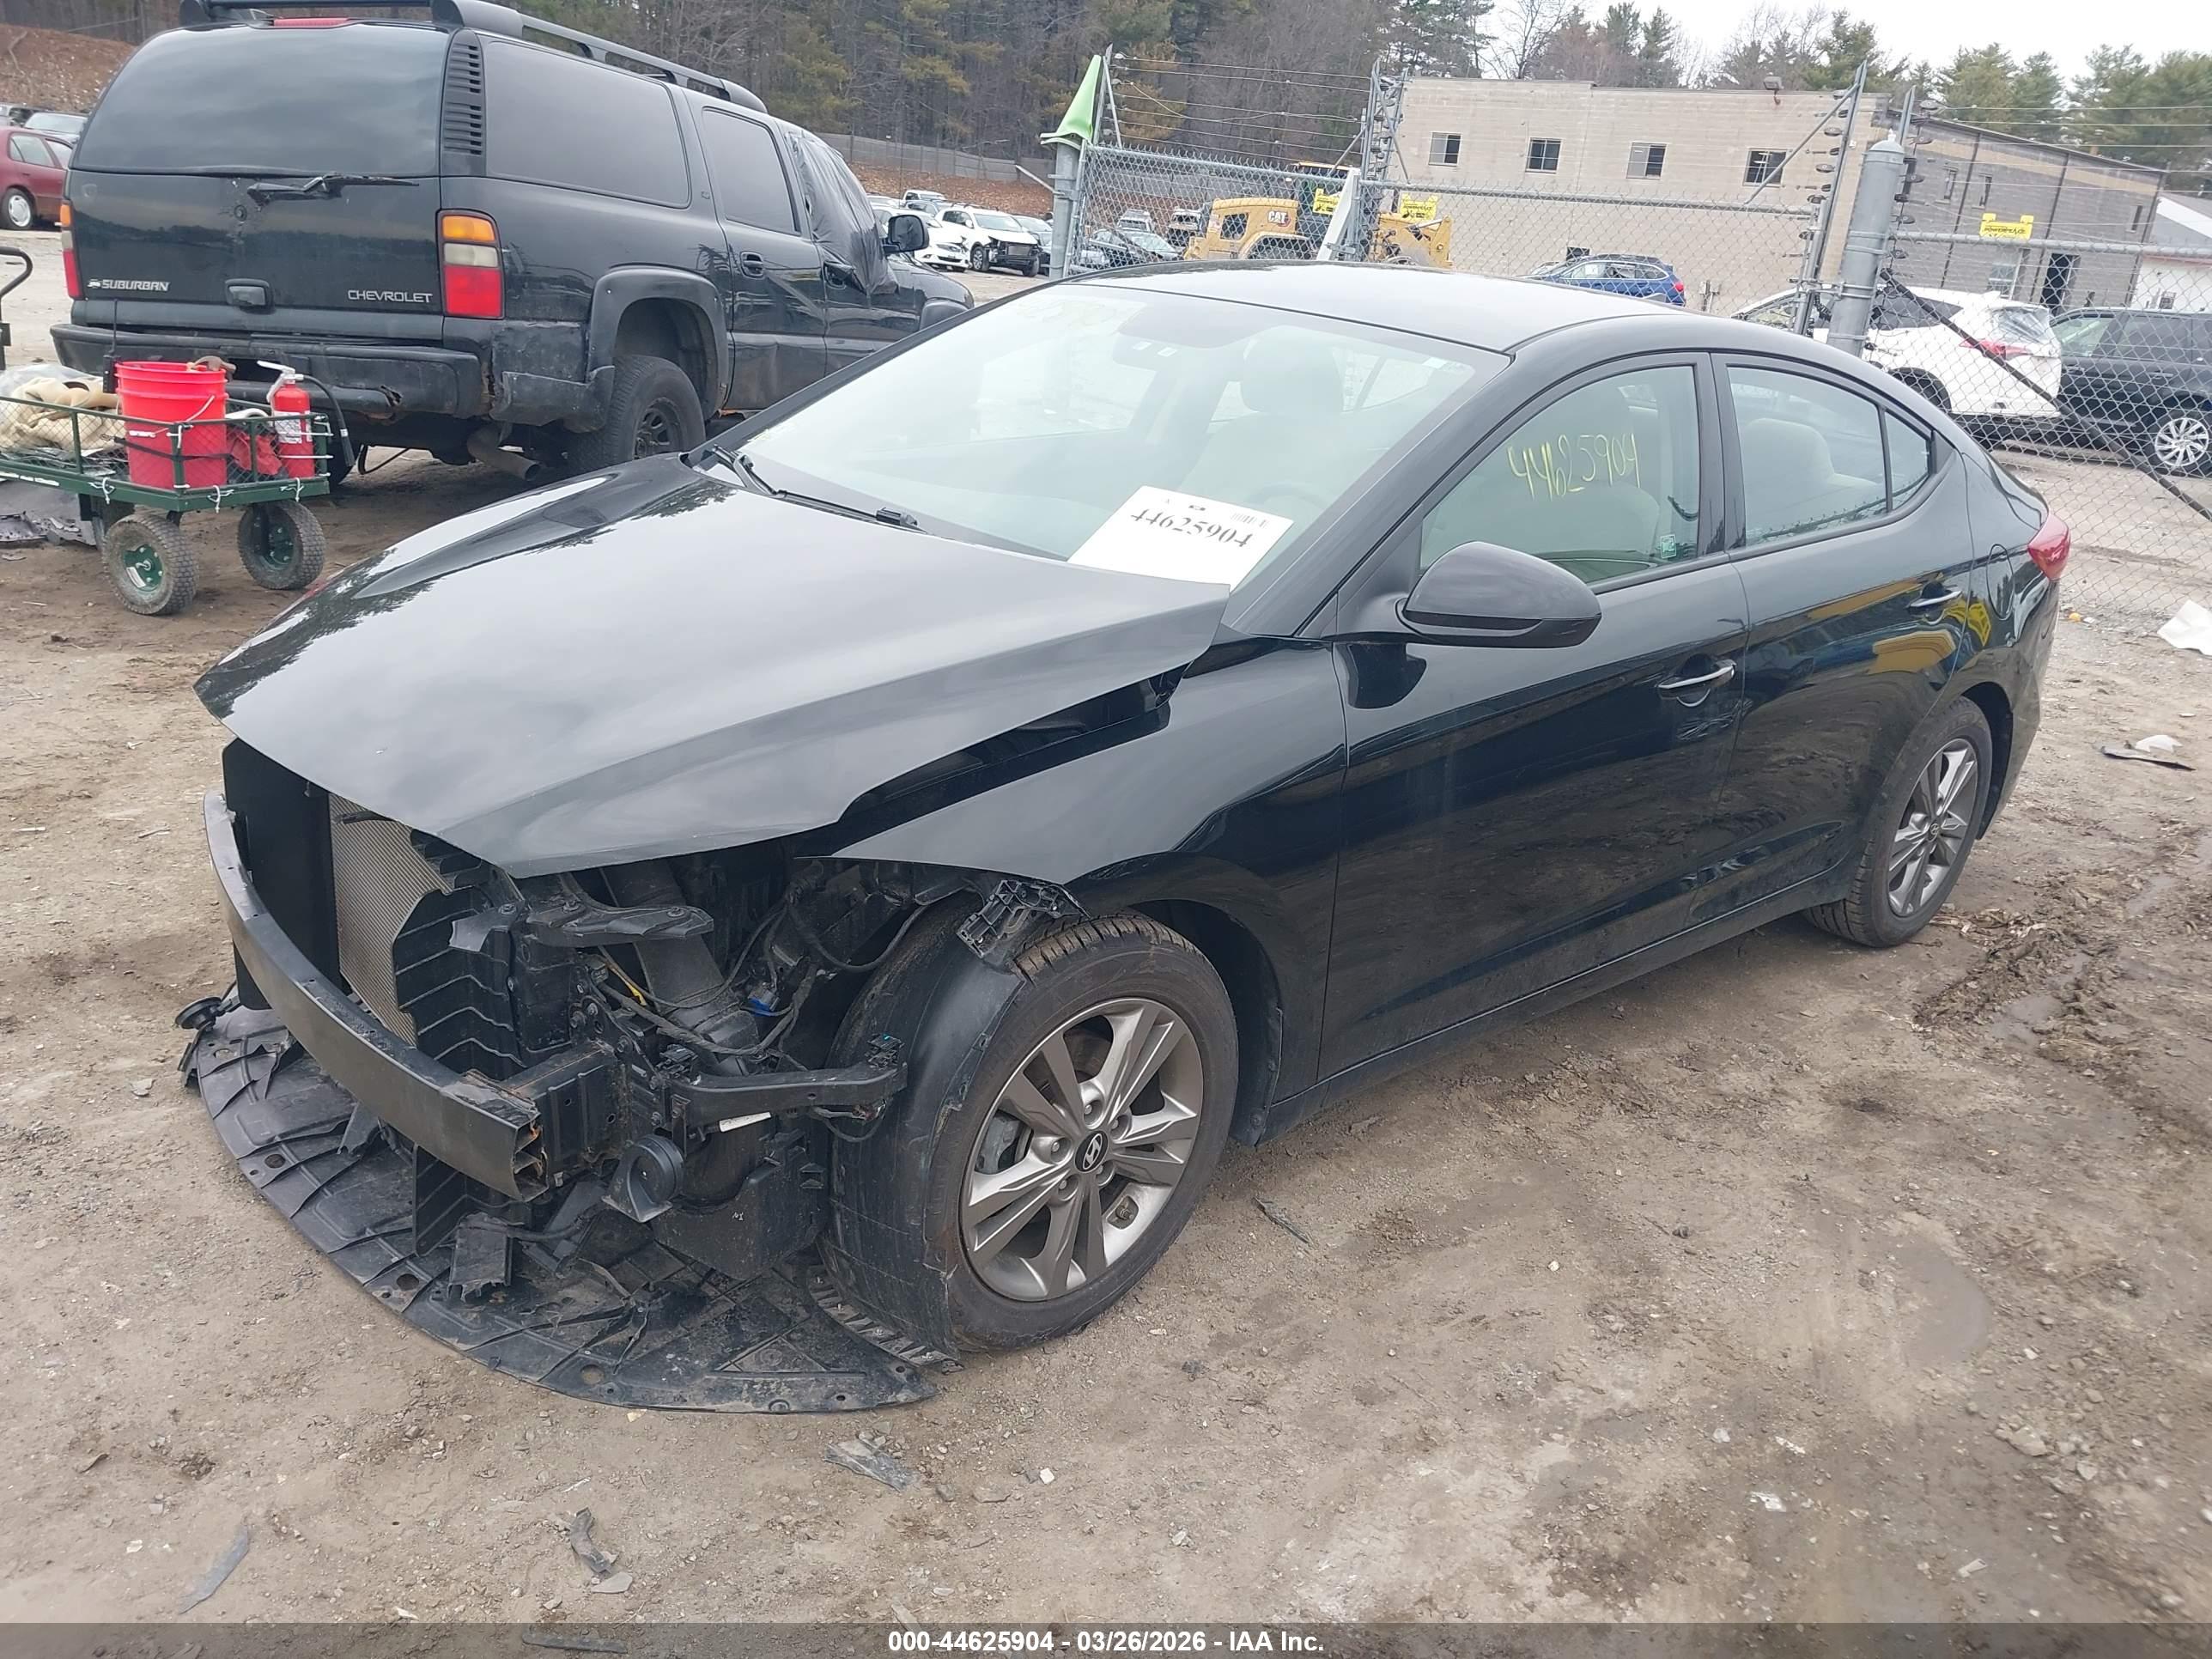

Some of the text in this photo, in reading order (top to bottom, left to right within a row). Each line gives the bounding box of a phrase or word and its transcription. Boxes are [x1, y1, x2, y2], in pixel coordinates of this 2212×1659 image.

[1267, 210, 1287, 223] CAT
[100, 279, 170, 291] SUBURBAN
[347, 290, 433, 303] CHEVROLET
[1508, 433, 1640, 501] 44625904
[1130, 508, 1254, 548] 44625904
